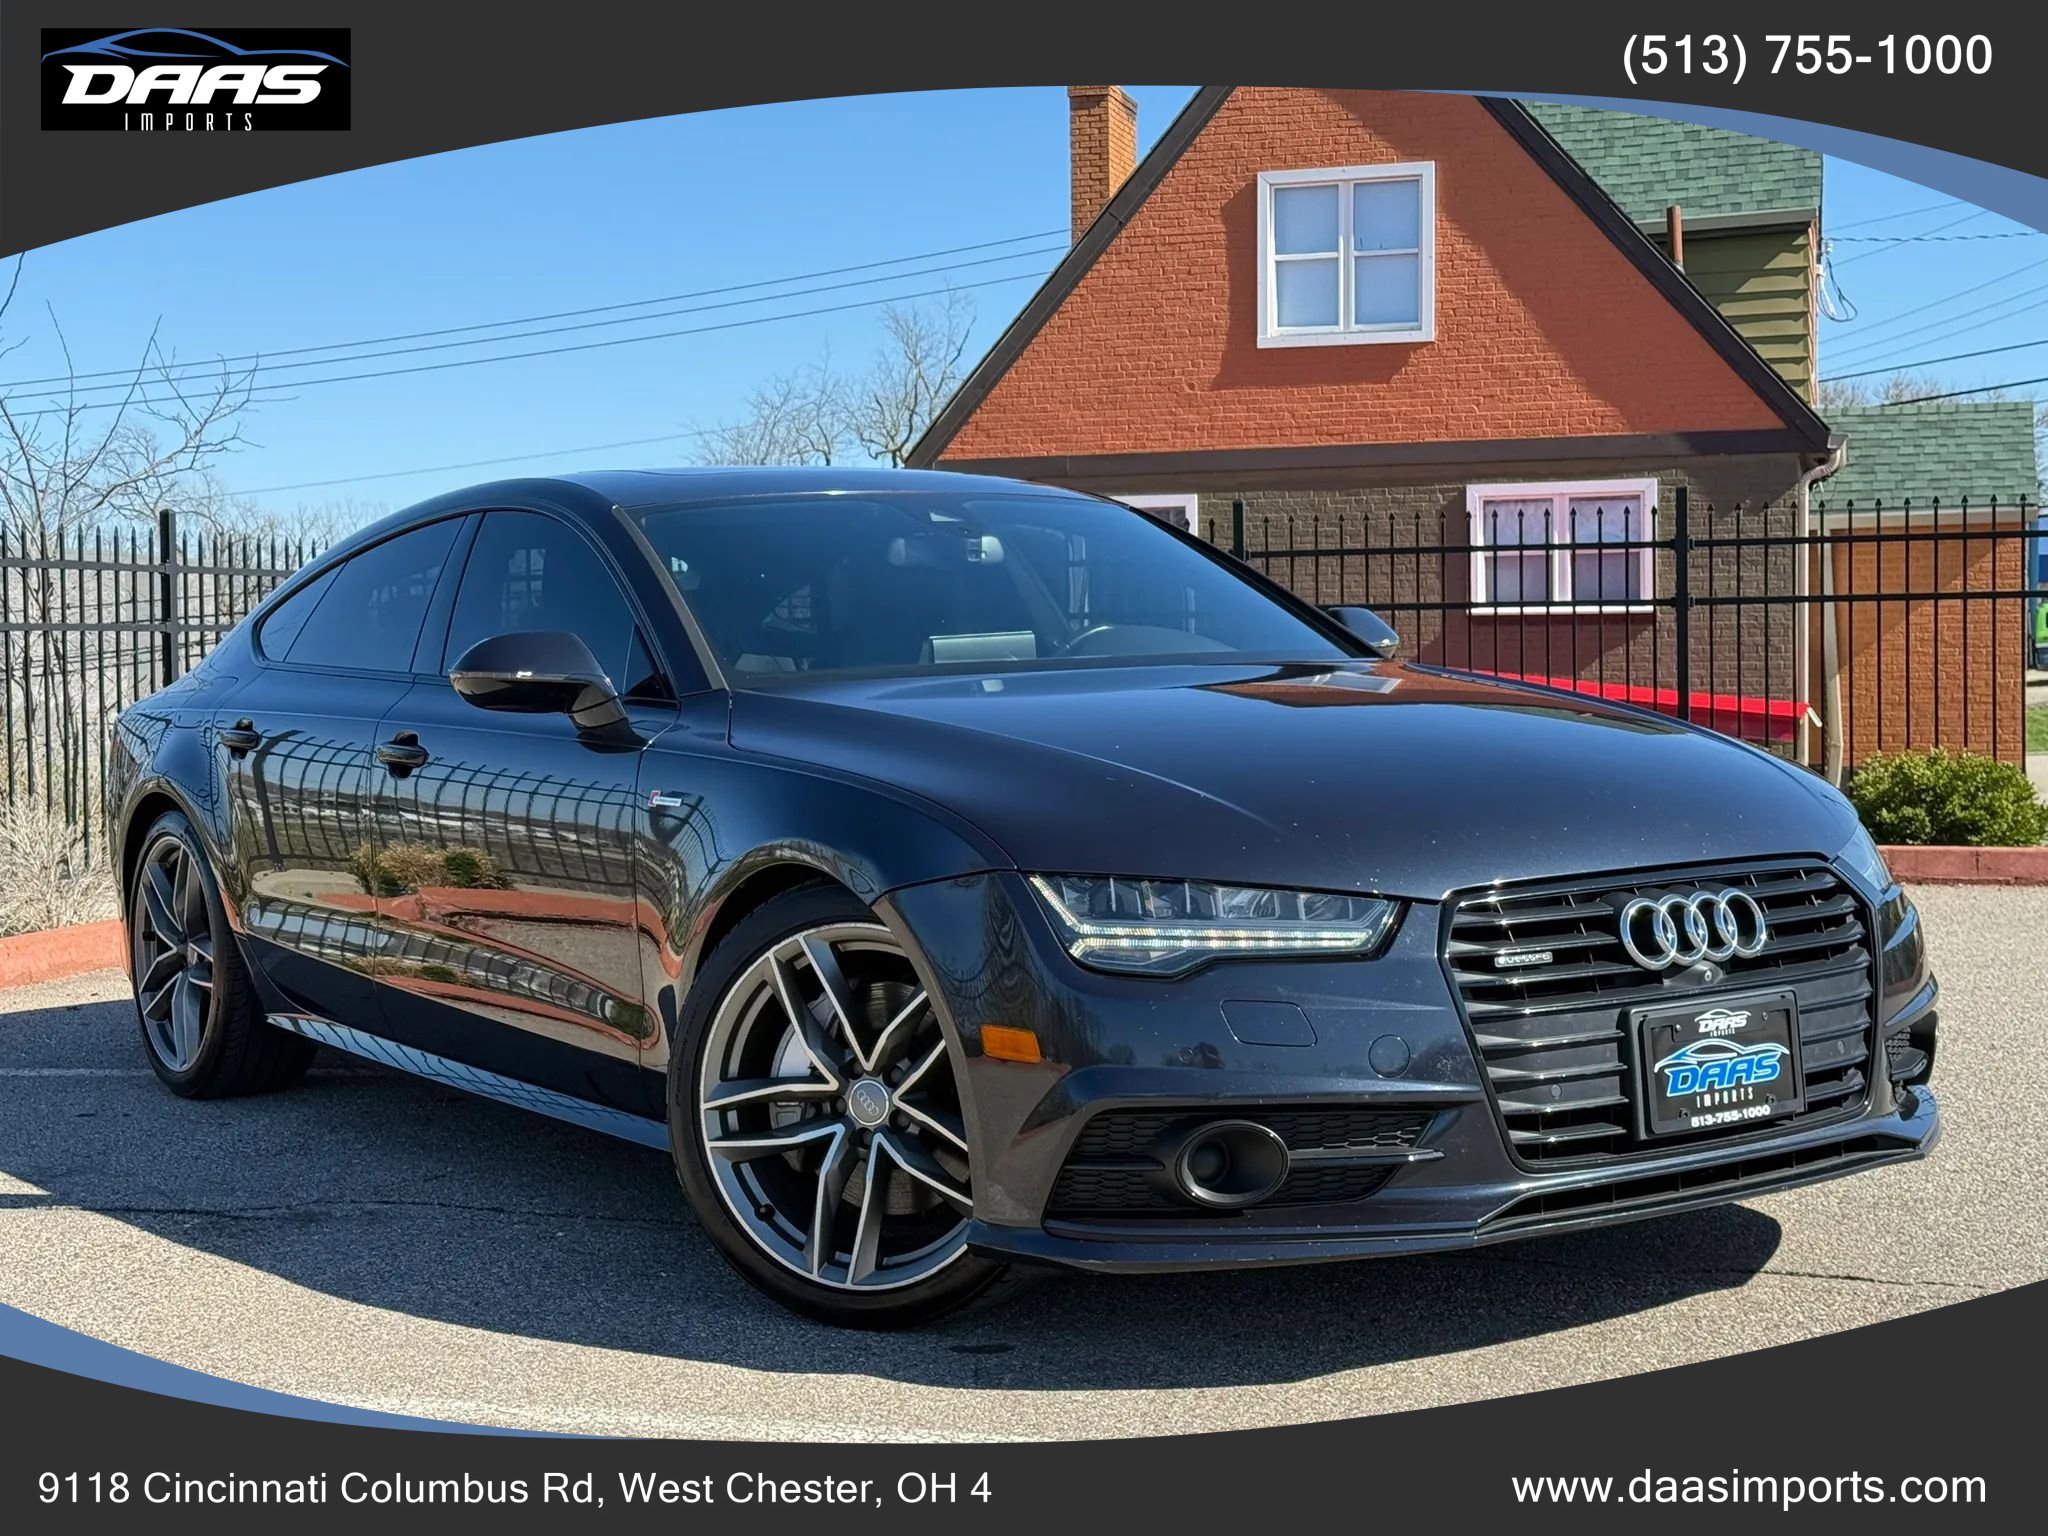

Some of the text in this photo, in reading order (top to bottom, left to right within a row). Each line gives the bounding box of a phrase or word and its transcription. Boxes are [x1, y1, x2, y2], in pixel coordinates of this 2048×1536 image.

[1698, 1014, 1747, 1033] DAAS
[1664, 1051, 1782, 1098] DAAS
[1696, 1087, 1754, 1109] IMPORTS
[1690, 1104, 1771, 1128] 513-755-1000
